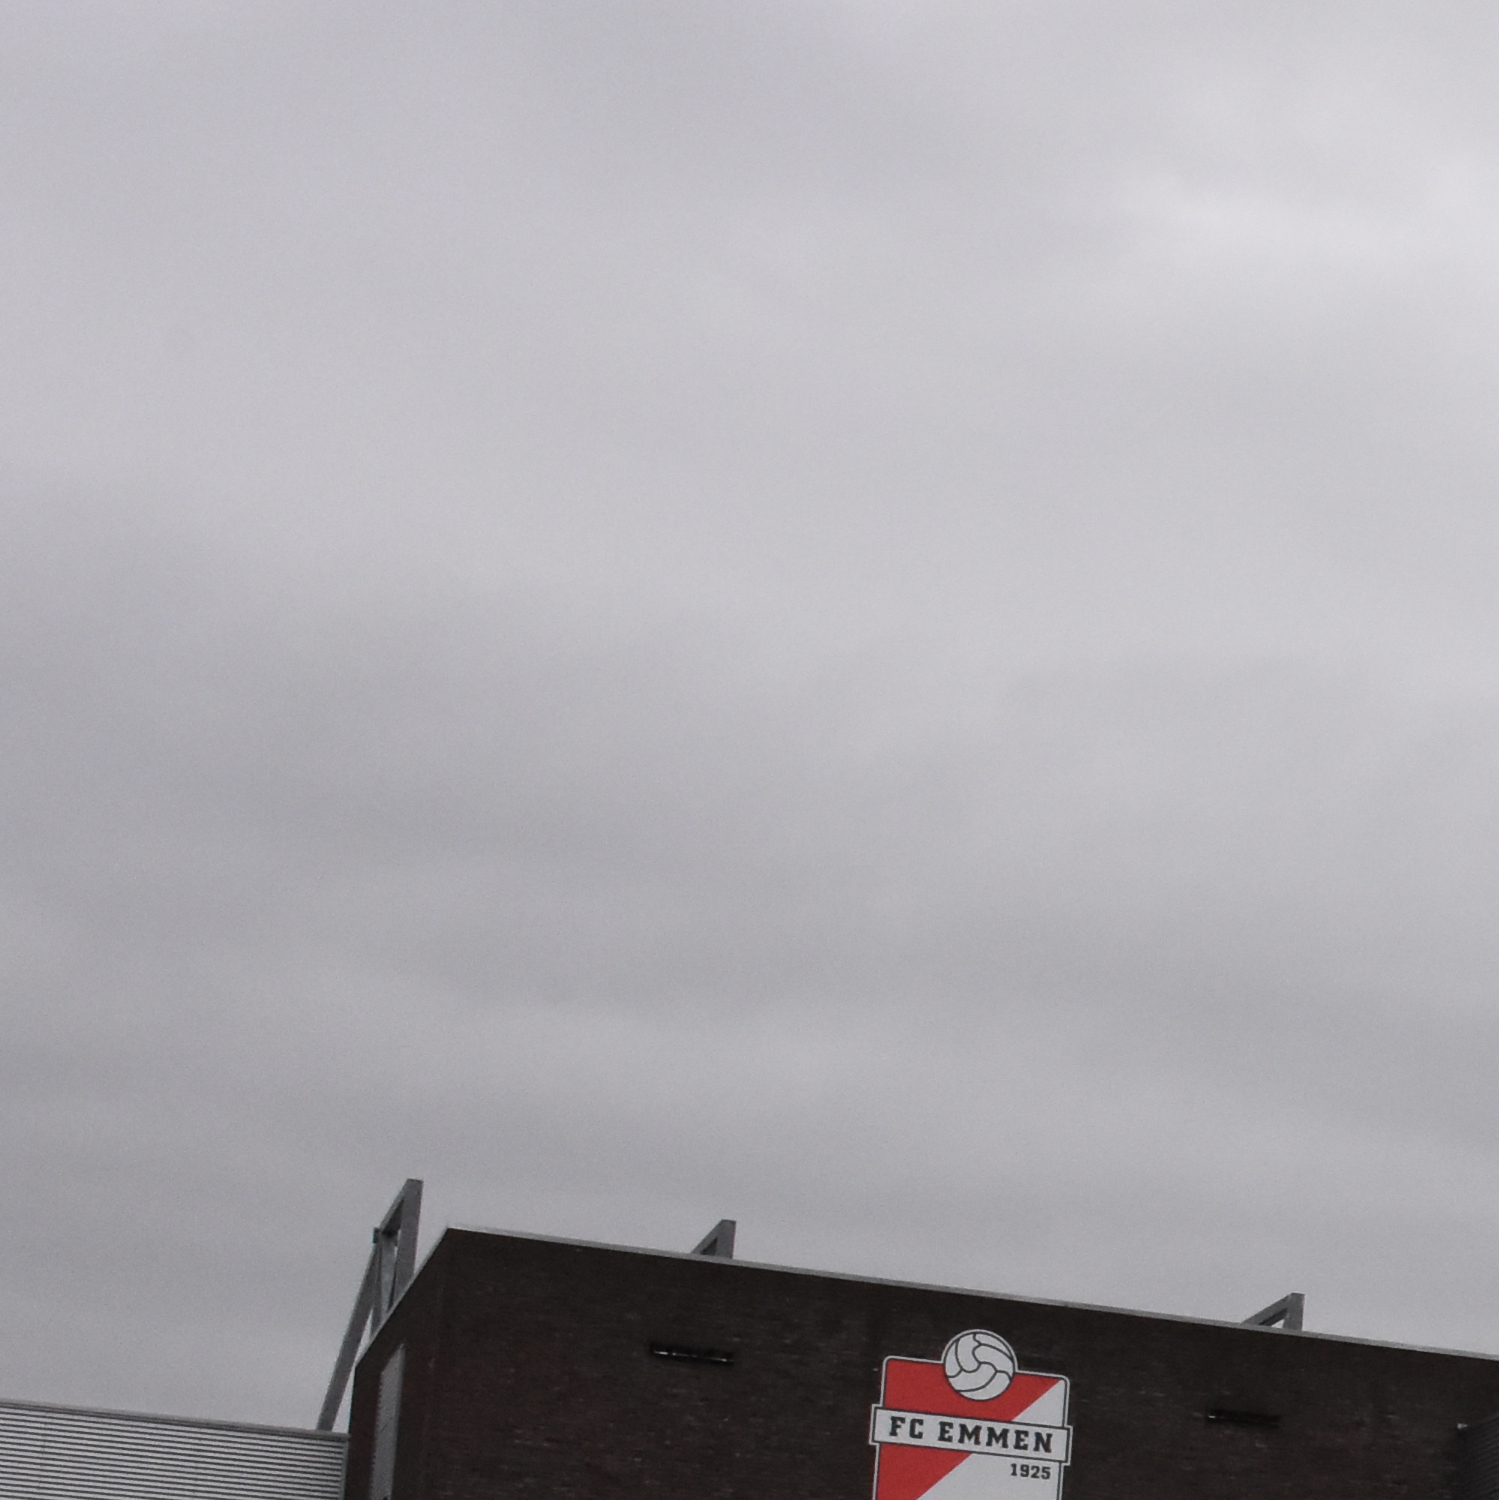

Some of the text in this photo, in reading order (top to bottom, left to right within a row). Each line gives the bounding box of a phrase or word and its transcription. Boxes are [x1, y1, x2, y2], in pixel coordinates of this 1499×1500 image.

[889, 1415, 1053, 1453] FC EMMEN
[1010, 1463, 1051, 1480] 1925
